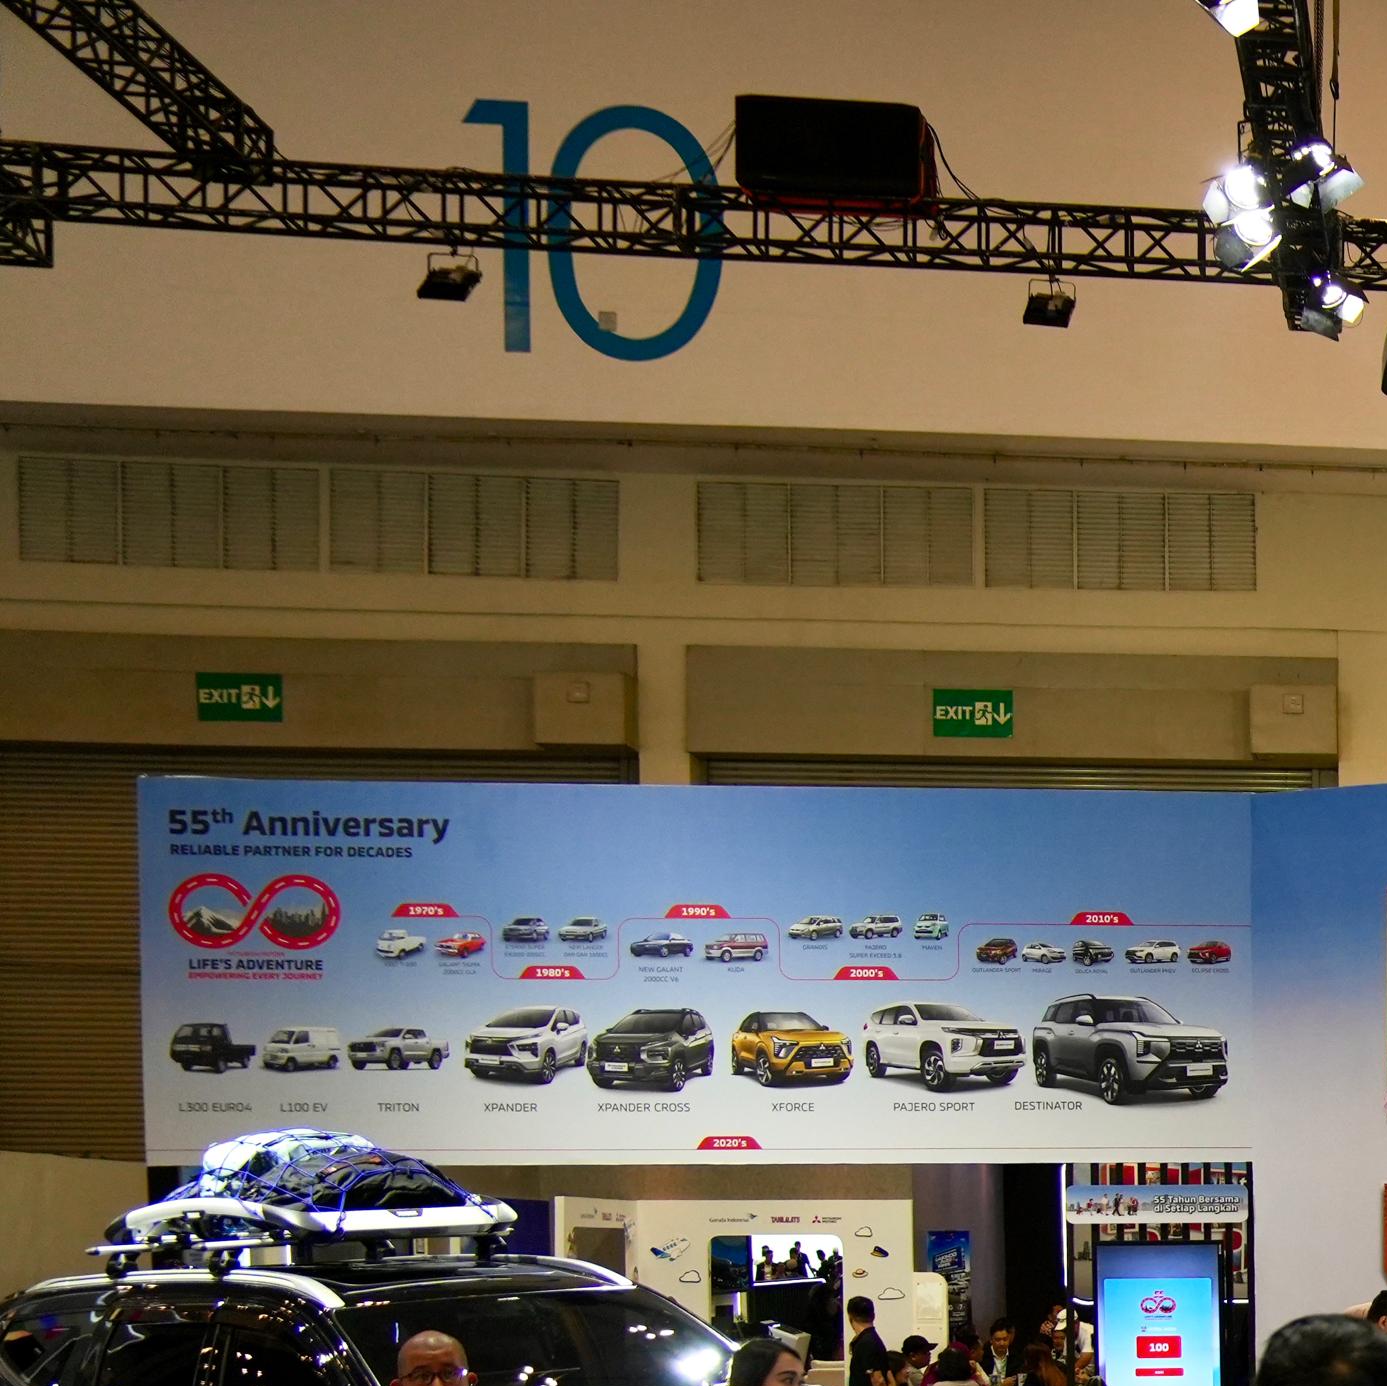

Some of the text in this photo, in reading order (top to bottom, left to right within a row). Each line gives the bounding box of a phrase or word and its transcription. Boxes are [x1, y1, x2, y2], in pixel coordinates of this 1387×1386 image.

[462, 99, 723, 361] 10
[198, 688, 240, 704] EXIT
[935, 705, 973, 720] EXIT
[168, 808, 450, 845] 55th Anniversary
[170, 844, 413, 858] RELIABLE PARTNER FOR DECADES
[408, 906, 445, 915] 1970's
[681, 907, 716, 916] 1990's
[1085, 914, 1119, 923] 2010's
[188, 958, 323, 971] LIFE'S ADVENTURE
[252, 972, 280, 980] EVERY
[282, 972, 324, 980] JOURNEY
[535, 968, 571, 977] 1980's
[849, 969, 884, 978] 2000's
[178, 1102, 253, 1113] L300 EURO4
[279, 1102, 328, 1113] L100 EV
[377, 1102, 420, 1112] TRITON
[483, 1102, 538, 1112] XPANDER
[597, 1102, 691, 1112] XPANDER CROSS
[771, 1102, 815, 1112] XFORCE
[893, 1101, 975, 1112] PAJERO SPORT
[1014, 1100, 1083, 1111] DESTINATOR
[712, 1138, 748, 1148] 2020's
[1168, 1195, 1197, 1204] Tahun
[1198, 1195, 1240, 1204] Bersama
[1153, 1204, 1239, 1214] di Setiap Langkah
[1149, 1342, 1170, 1353] 100
